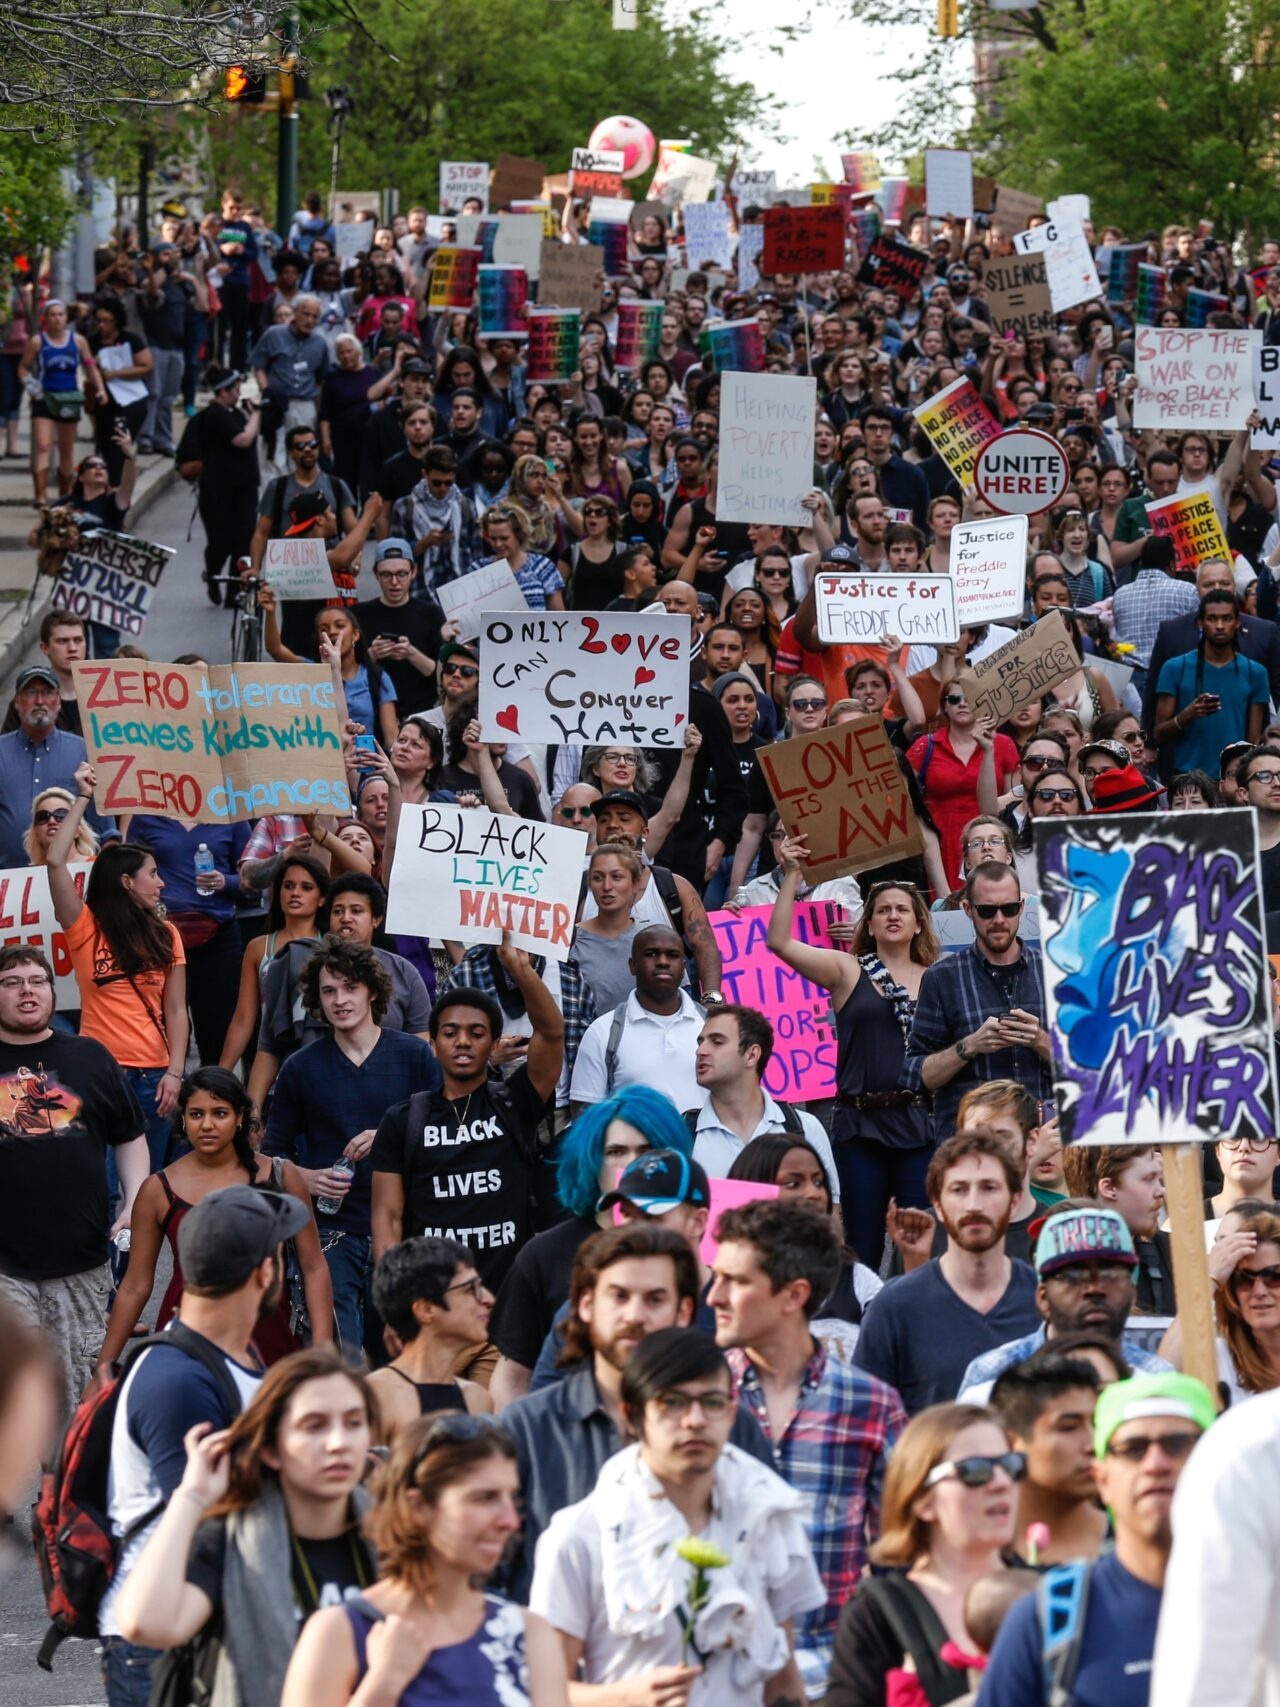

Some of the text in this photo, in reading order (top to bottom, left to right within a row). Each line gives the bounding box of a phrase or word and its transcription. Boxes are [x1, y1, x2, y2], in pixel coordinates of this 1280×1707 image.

[449, 167, 482, 180] STOP
[985, 261, 1048, 293] SILENCE
[1136, 329, 1249, 361] STOP THE
[1150, 360, 1238, 386] WAR ON
[735, 385, 809, 423] HELPING
[1137, 385, 1241, 404] POOR BLACK
[1160, 400, 1230, 419] PEOPLE!
[923, 418, 940, 435] NO
[933, 408, 985, 451] NO PEACE
[726, 427, 812, 461] POVERTY
[944, 421, 998, 466] NO RACIST
[741, 464, 784, 484] HELPS
[984, 455, 1060, 474] UNITE
[984, 476, 1057, 495] HERE!
[959, 530, 1015, 545] Justice
[1177, 521, 1216, 543] PEACE
[1184, 533, 1223, 558] RACIST
[269, 541, 320, 566] CNN
[956, 550, 981, 561] for
[956, 561, 1008, 575] Freddie
[60, 554, 147, 615] TAYLOR
[822, 578, 940, 599] Justice for
[956, 577, 991, 590] Gray
[52, 583, 143, 636] DILLON
[898, 602, 950, 638] GRAY!
[486, 620, 569, 644] ONLY
[492, 650, 549, 689] CAN
[972, 640, 1077, 720] JUSTICE
[997, 655, 1024, 679] FOR
[79, 667, 336, 715] ZERO tolerance
[90, 712, 341, 758] leaves Kids with
[763, 724, 892, 800] LOVE
[96, 755, 350, 818] ZERO chances
[791, 769, 900, 819] IS THE
[418, 808, 548, 864] BLACK
[790, 794, 910, 868] LAW
[452, 857, 544, 895] LIVES
[1113, 841, 1263, 958] BLACK
[459, 889, 572, 948] MATTER
[423, 1115, 504, 1147] BLACK
[432, 1168, 503, 1198] LIVES
